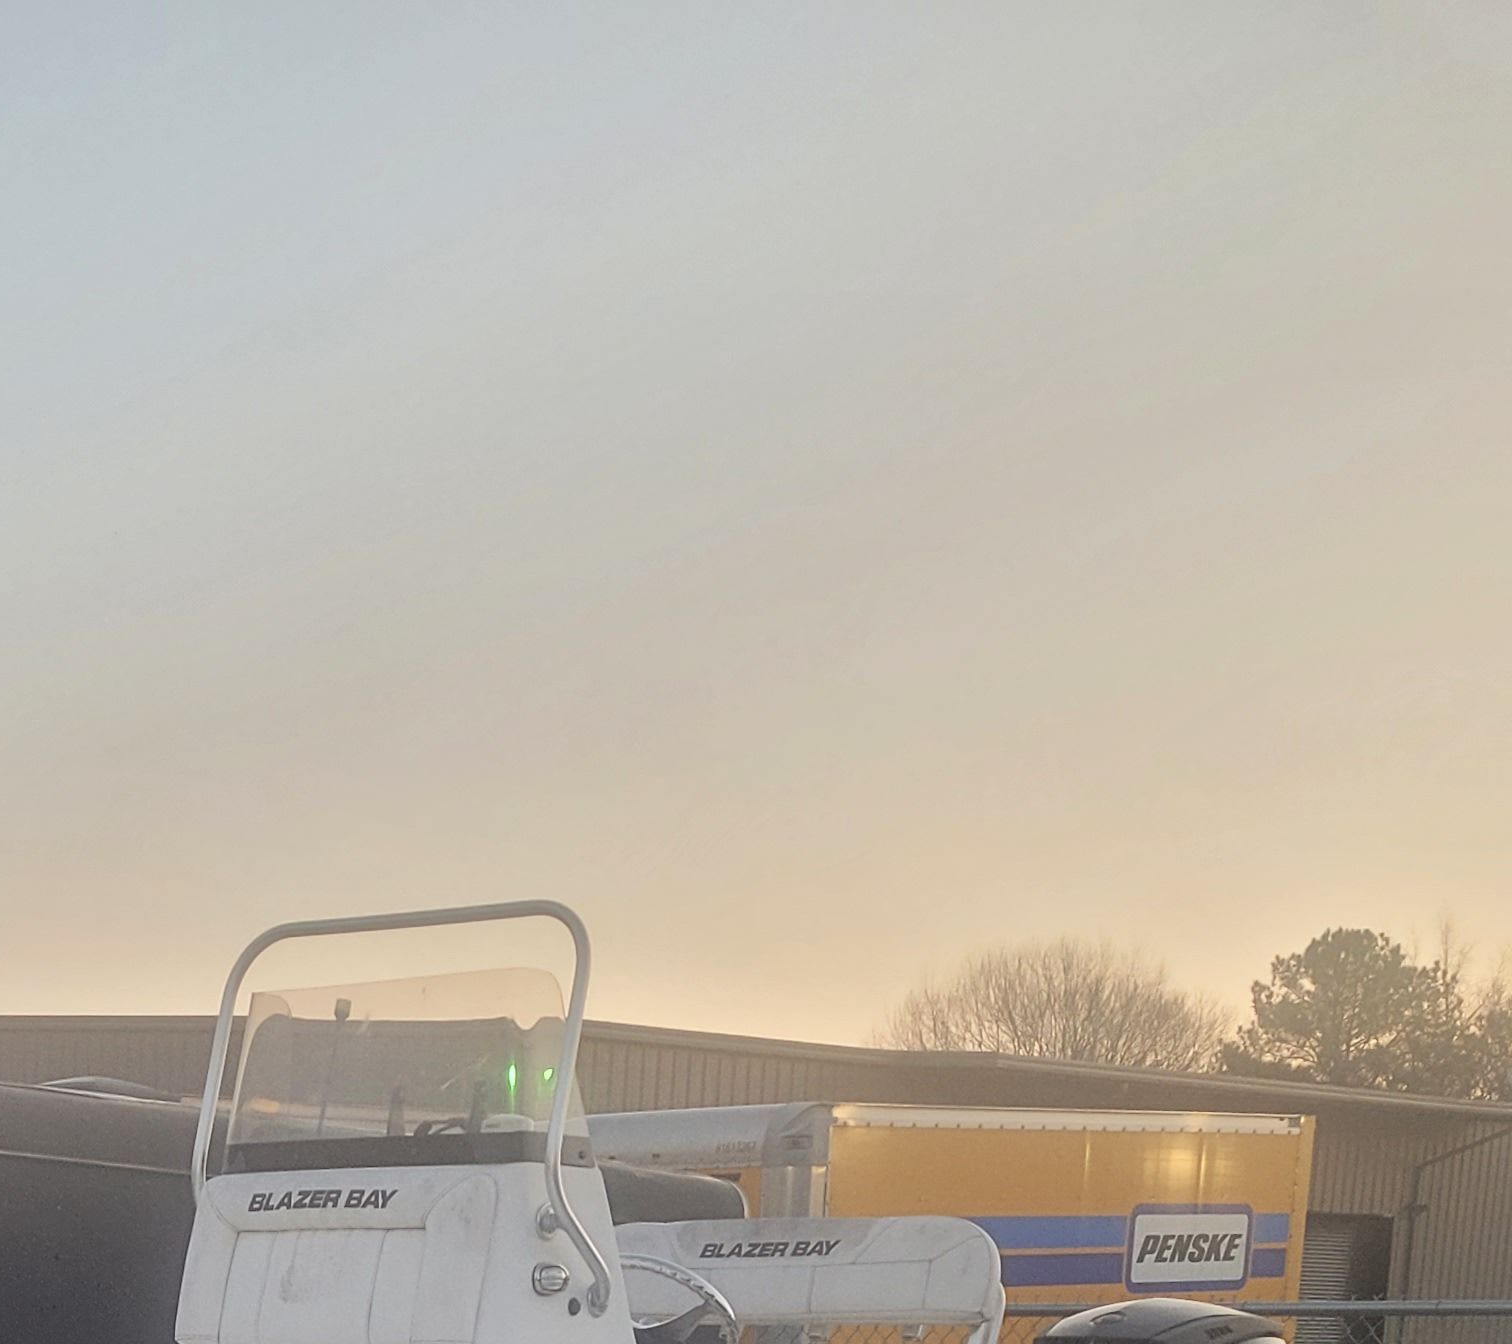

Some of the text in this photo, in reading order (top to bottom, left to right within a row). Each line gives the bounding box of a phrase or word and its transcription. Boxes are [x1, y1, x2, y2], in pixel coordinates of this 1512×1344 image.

[248, 1189, 399, 1212] BLAZER BAY
[699, 1240, 841, 1258] BLAZER BAY
[1136, 1233, 1243, 1263] PENSKE
